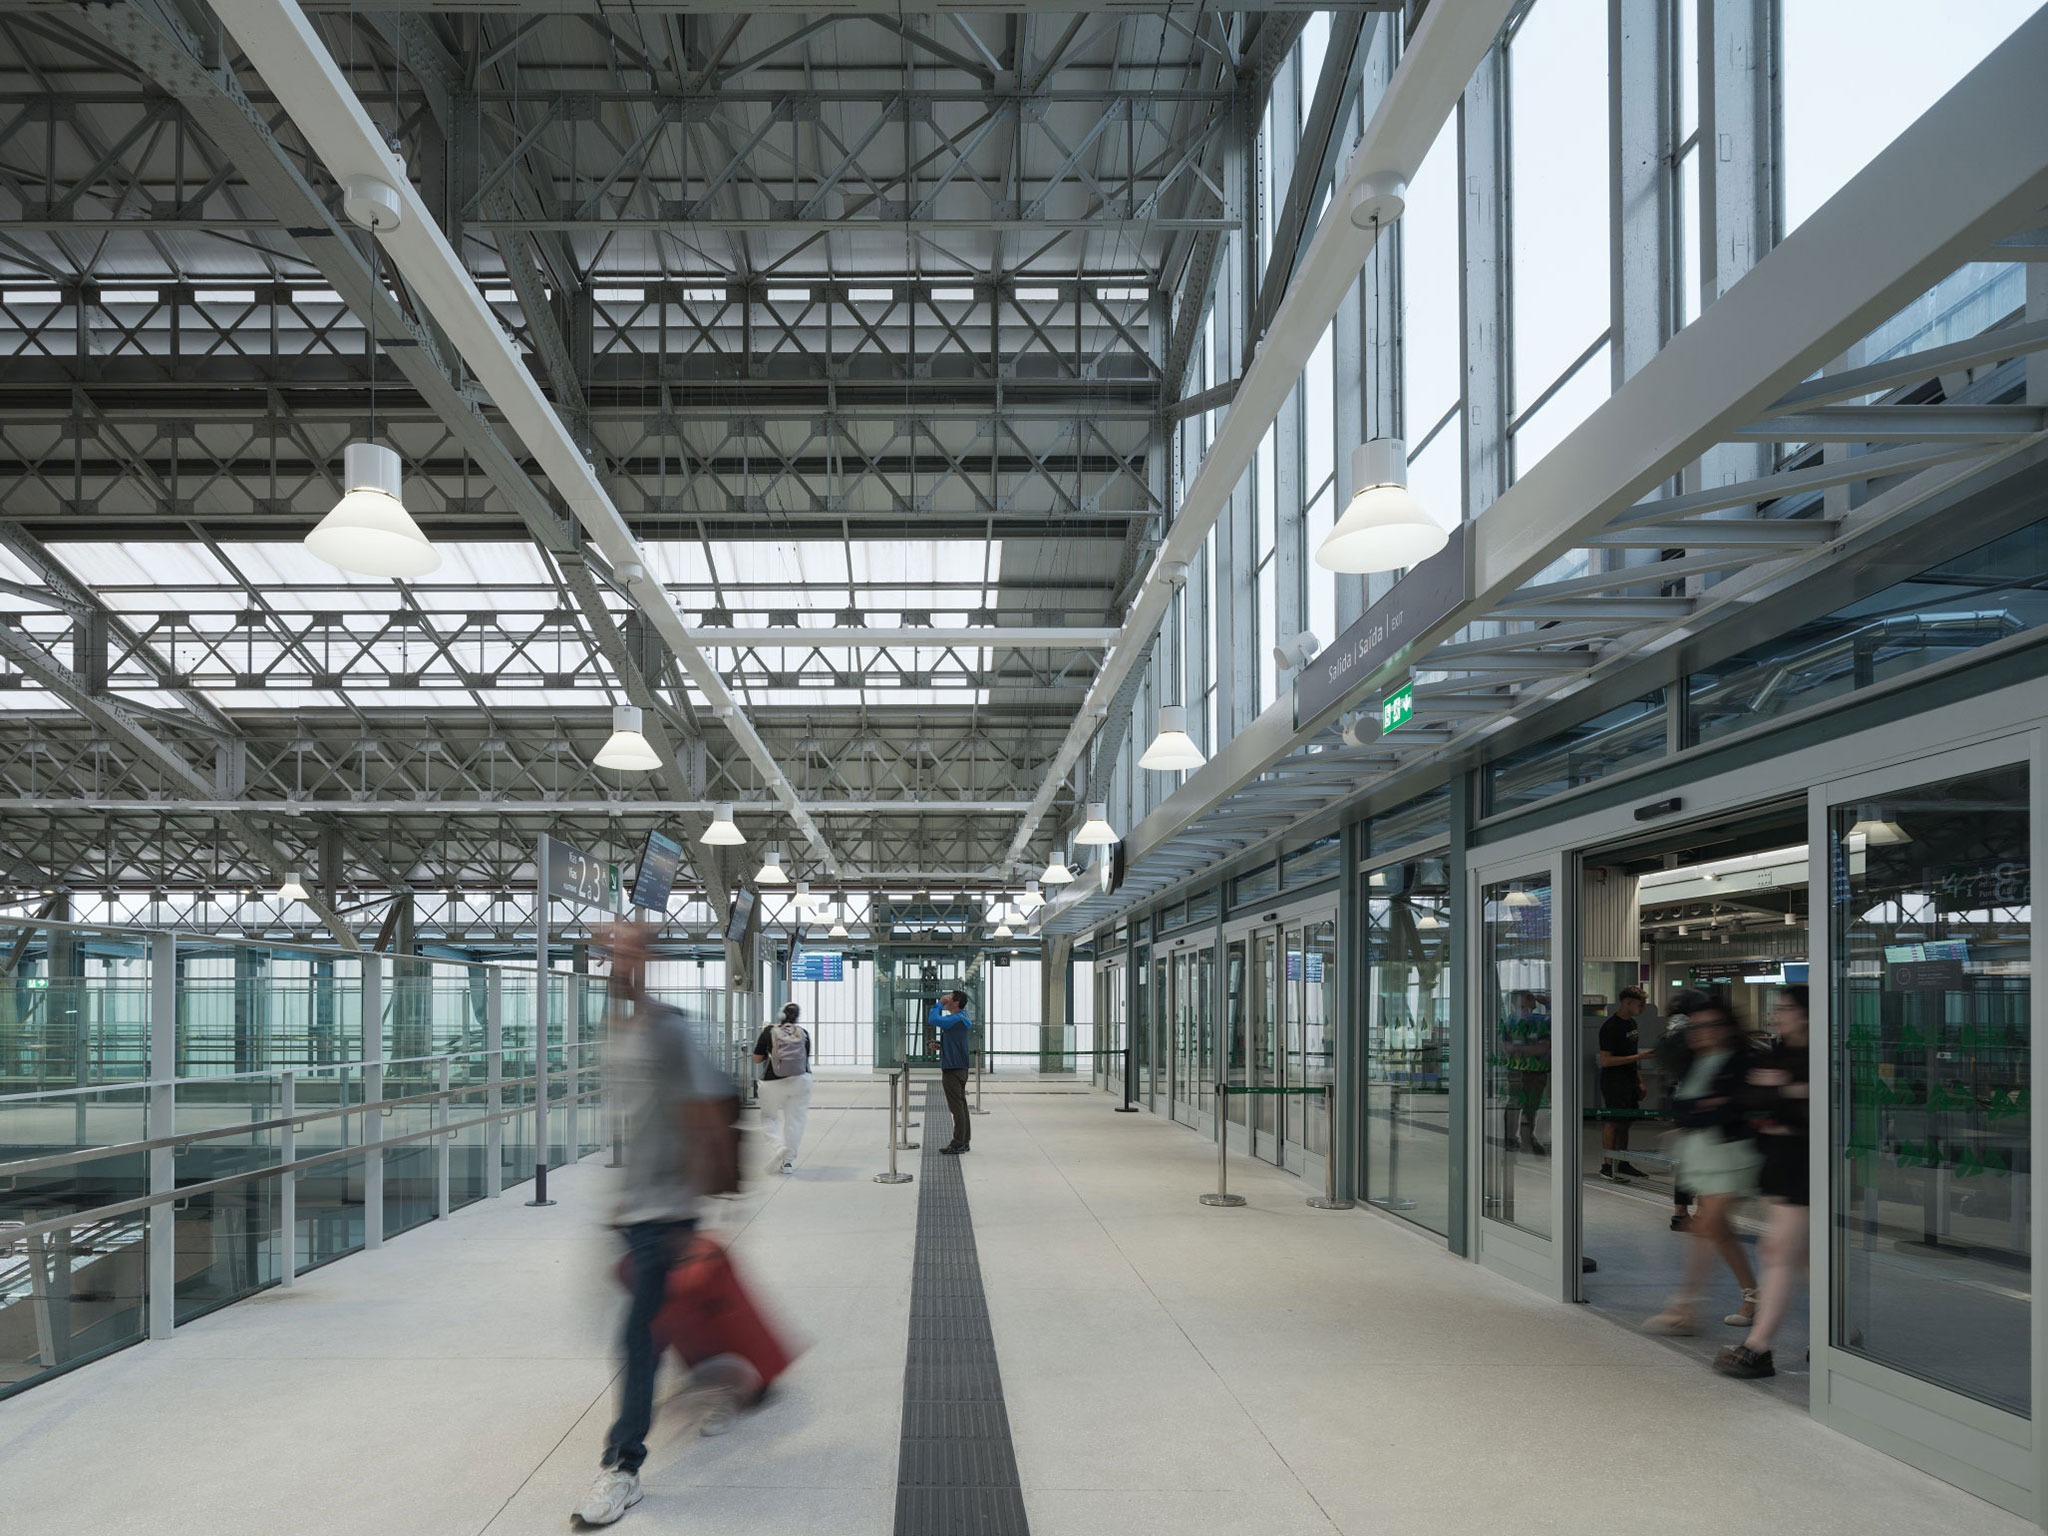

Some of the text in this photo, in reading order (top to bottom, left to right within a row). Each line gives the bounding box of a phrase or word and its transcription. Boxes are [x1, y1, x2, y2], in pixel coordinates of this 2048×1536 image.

[1328, 610, 1404, 684] Salida Saída EXIT
[578, 856, 586, 898] 2
[593, 863, 600, 903] 3
